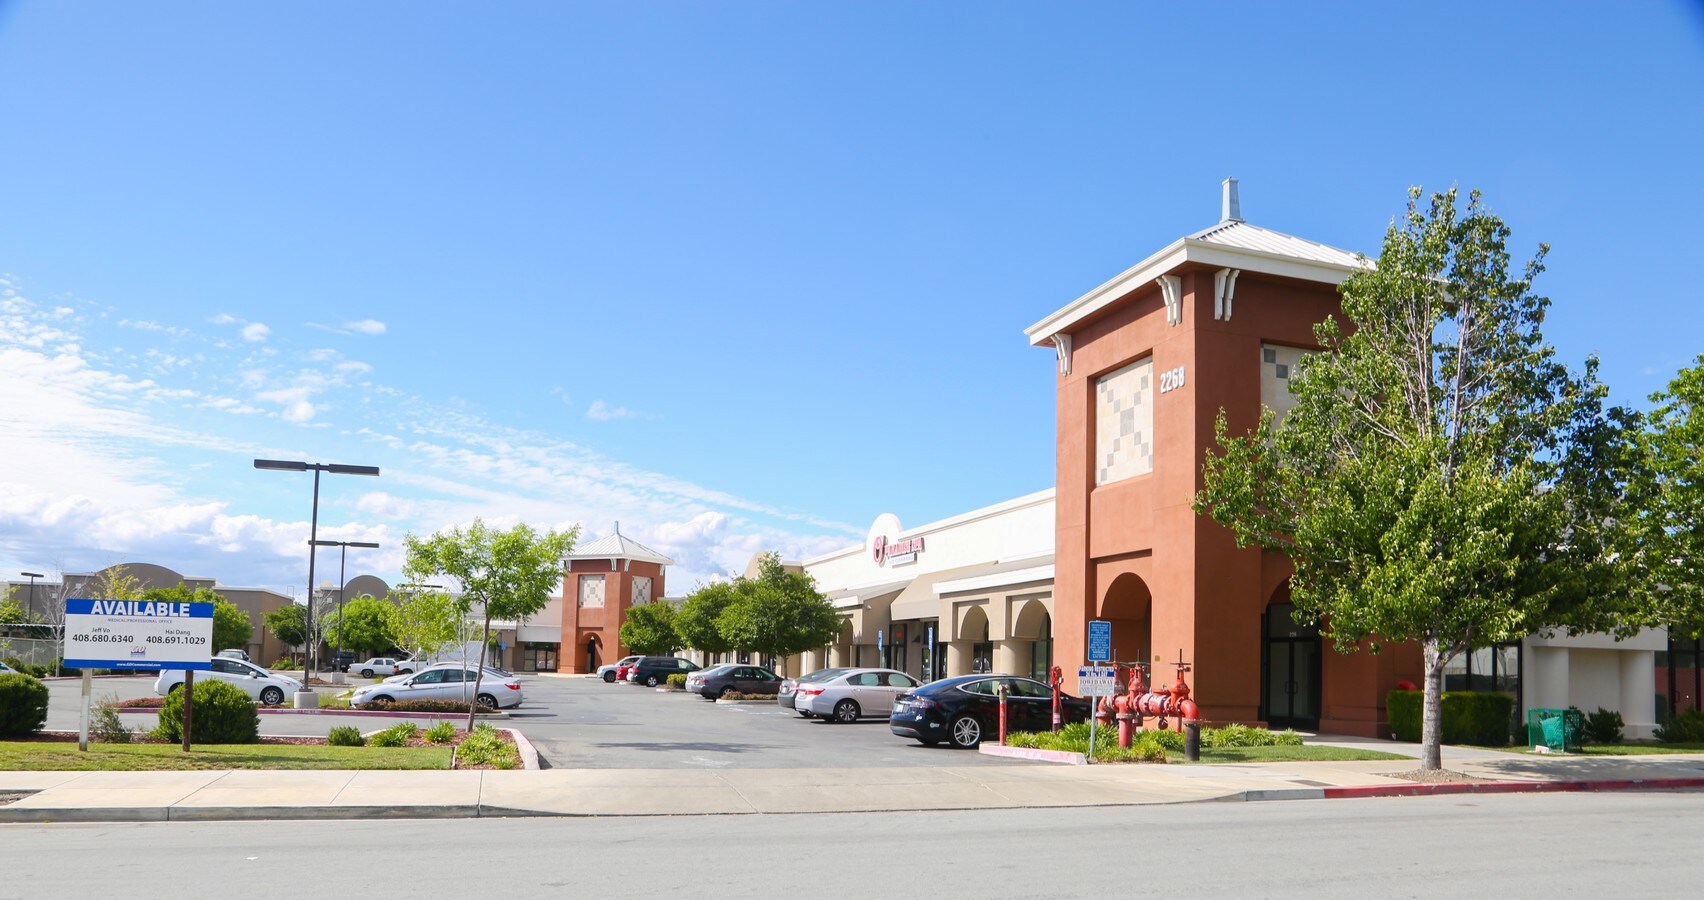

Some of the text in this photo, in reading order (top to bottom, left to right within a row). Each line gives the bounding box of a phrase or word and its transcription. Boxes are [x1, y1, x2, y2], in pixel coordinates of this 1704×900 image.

[1160, 366, 1185, 393] 2268
[90, 600, 191, 617] AVAILABLE
[72, 634, 134, 643] 408.680.6340
[146, 635, 206, 645] 408.691.1029
